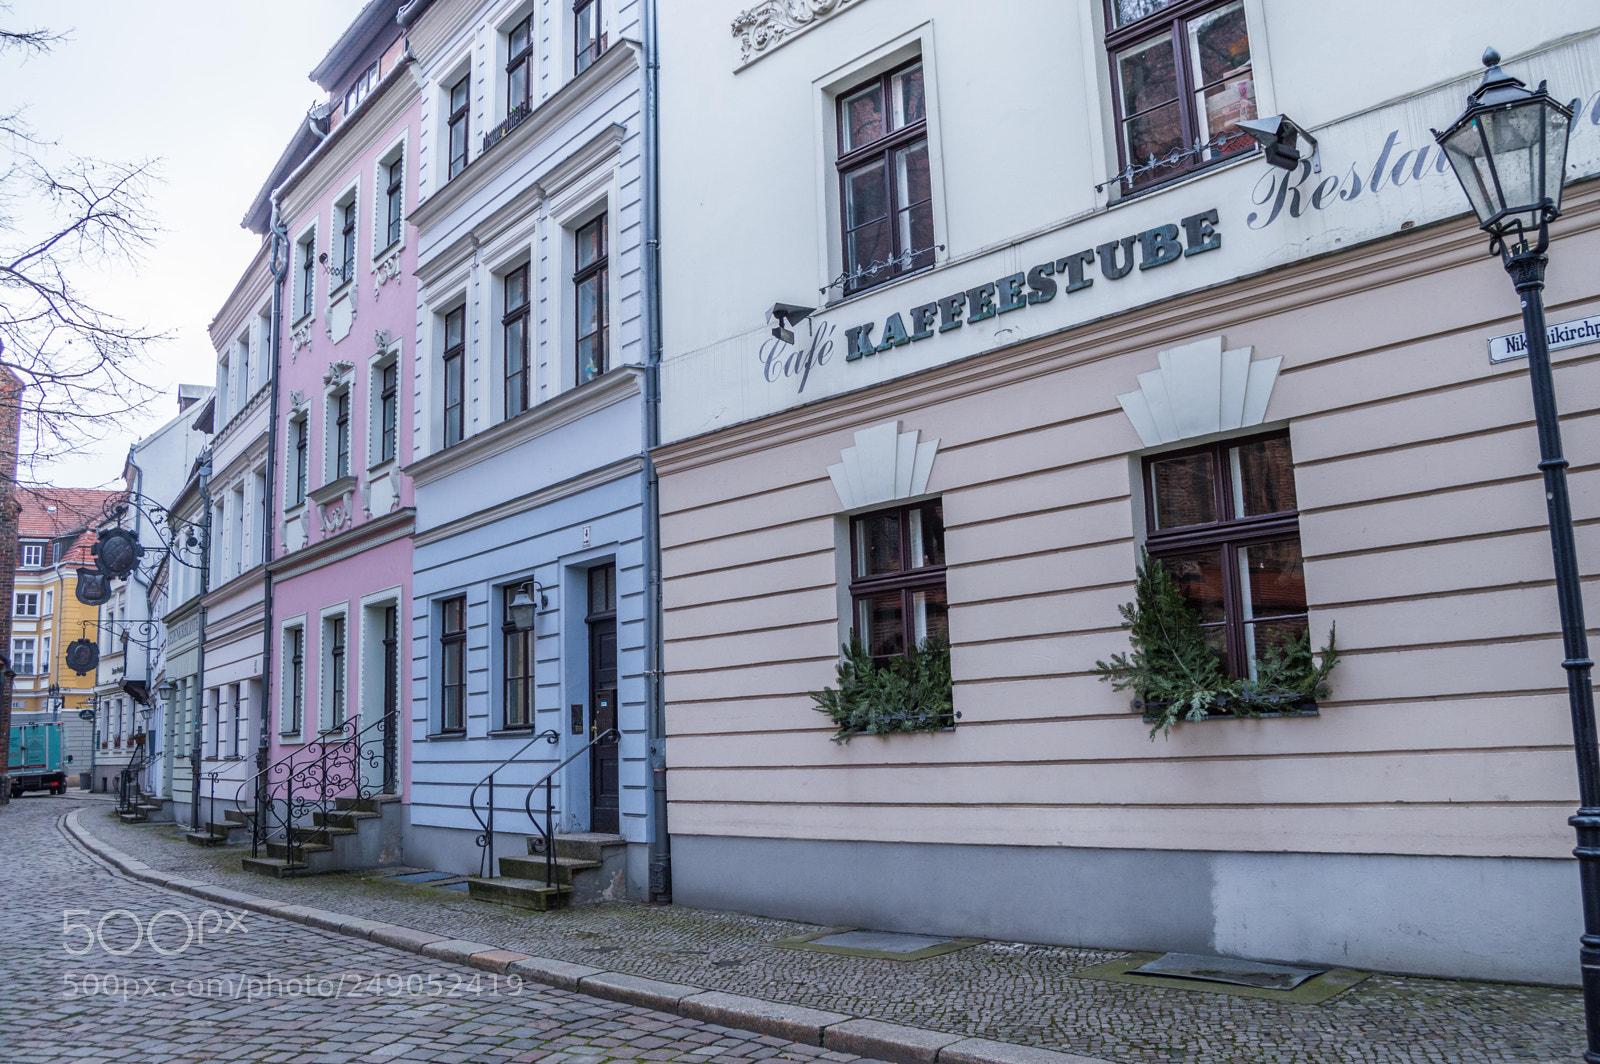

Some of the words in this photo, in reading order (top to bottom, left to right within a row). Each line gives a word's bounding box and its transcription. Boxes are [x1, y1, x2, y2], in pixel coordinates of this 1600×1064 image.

[758, 320, 837, 394] Café
[844, 206, 1223, 363] KAFFEESTUBE
[1505, 320, 1600, 354] Nikikirchp
